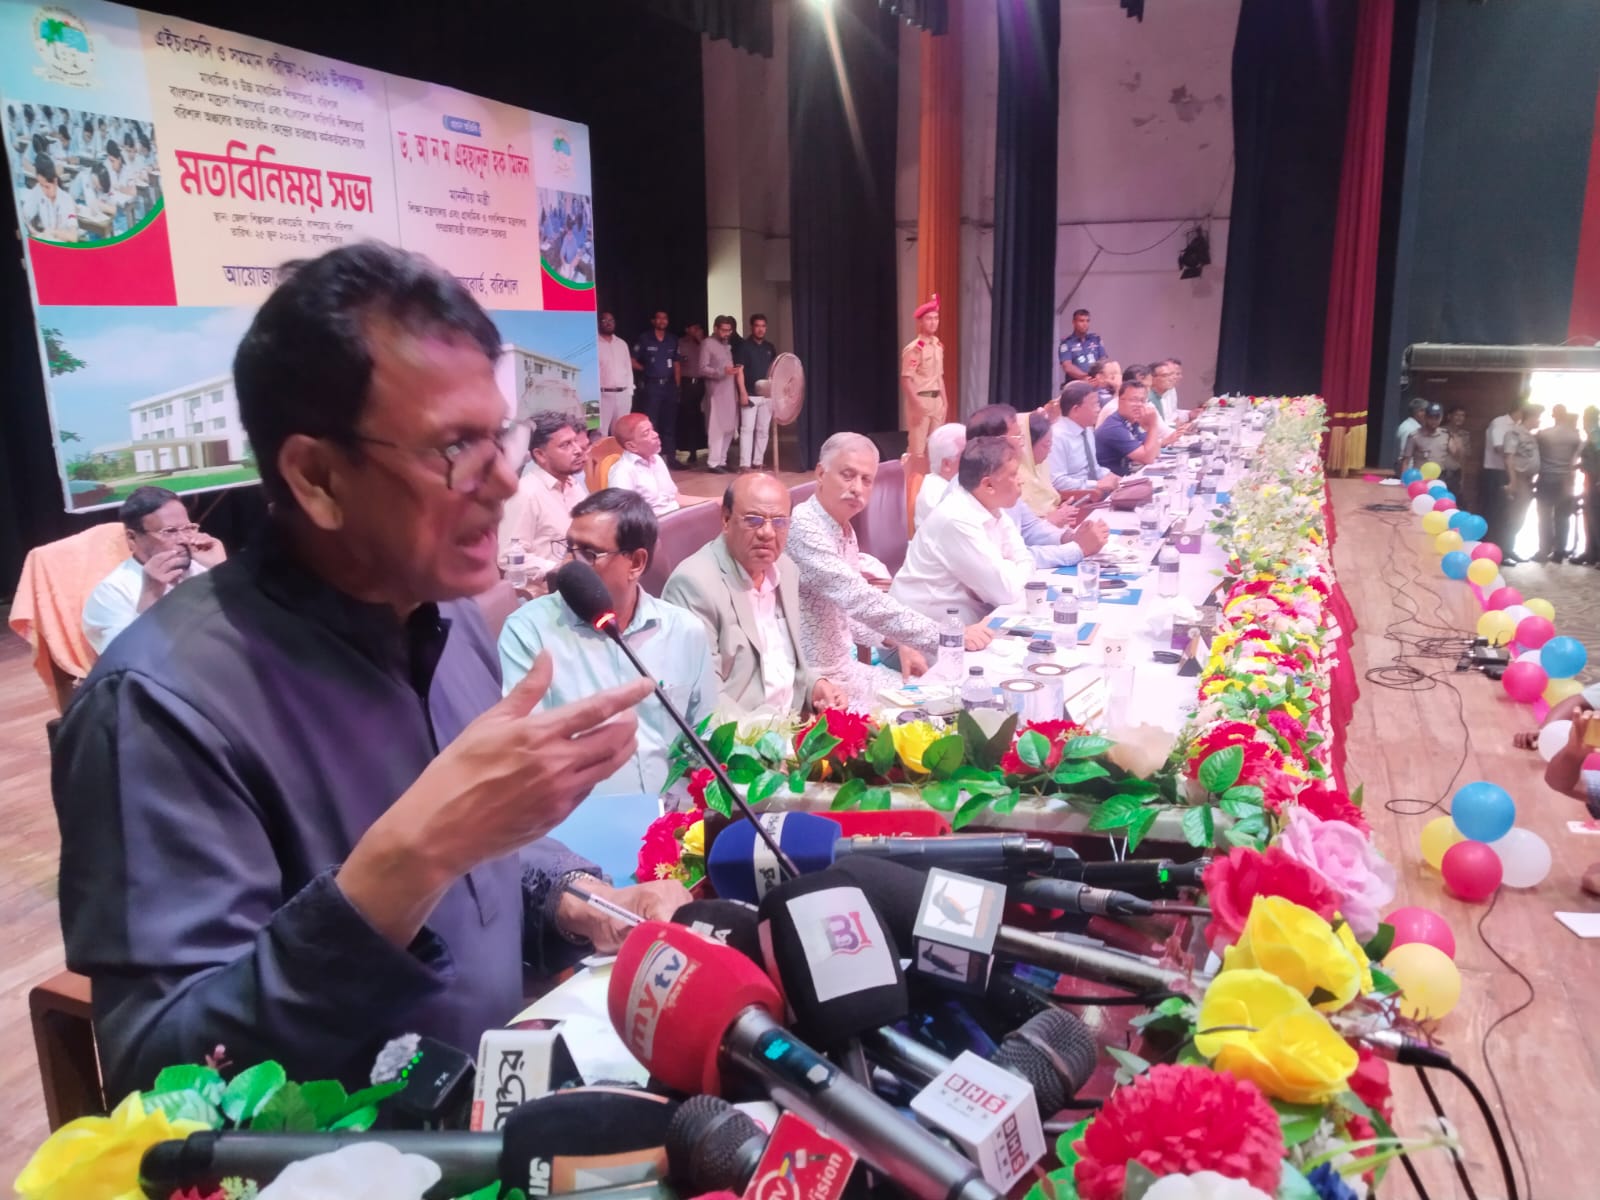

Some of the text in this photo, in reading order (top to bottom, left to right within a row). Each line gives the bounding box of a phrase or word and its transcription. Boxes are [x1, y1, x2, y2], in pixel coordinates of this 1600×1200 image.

[175, 139, 374, 213] মতবিনিময় সভা
[222, 264, 277, 287] আয়োজ
